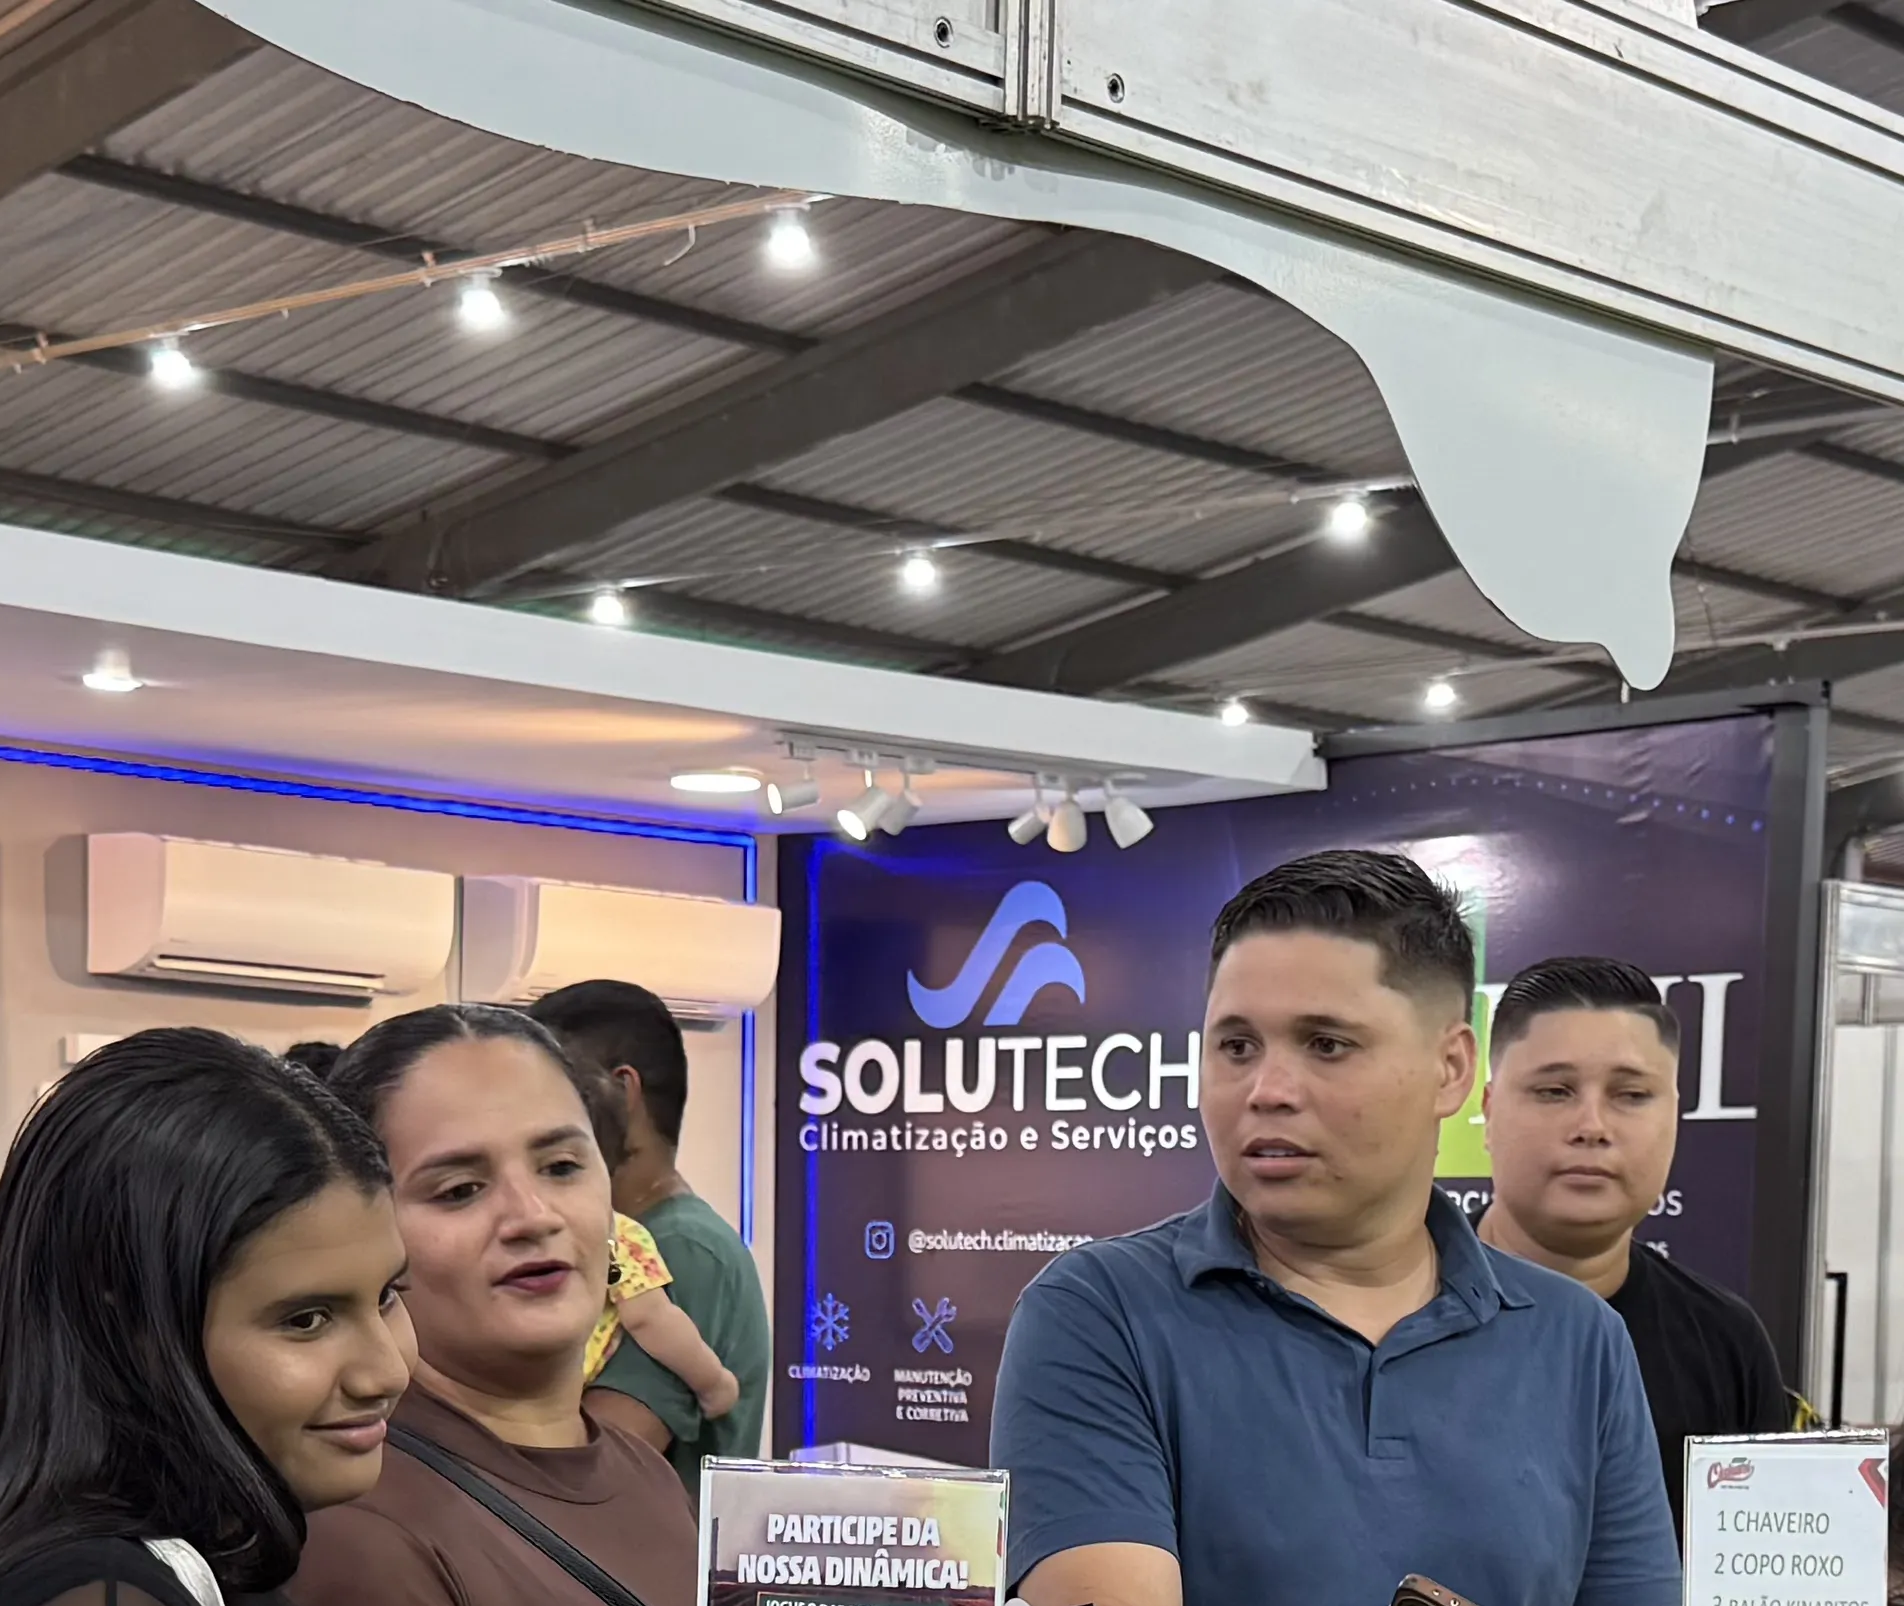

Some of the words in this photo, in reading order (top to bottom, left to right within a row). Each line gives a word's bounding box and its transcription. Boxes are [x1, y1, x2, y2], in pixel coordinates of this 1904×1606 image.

[799, 1032, 1201, 1115] SOLUTECH
[799, 1121, 1008, 1157] Climatização
[1019, 1125, 1039, 1150] e
[1051, 1117, 1198, 1157] Serviços
[894, 1367, 973, 1387] MANUTENÇÃO
[767, 1513, 898, 1546] PARTICIPE
[900, 1516, 941, 1548] DA
[1717, 1510, 1727, 1532] 1
[1734, 1510, 1830, 1535] CHAVEIRO
[737, 1553, 822, 1585] NOSSA
[824, 1548, 970, 1590] DINÂMICA!
[1714, 1553, 1725, 1575] 2
[1731, 1553, 1785, 1576] COPO
[1791, 1554, 1844, 1577] ROXO
